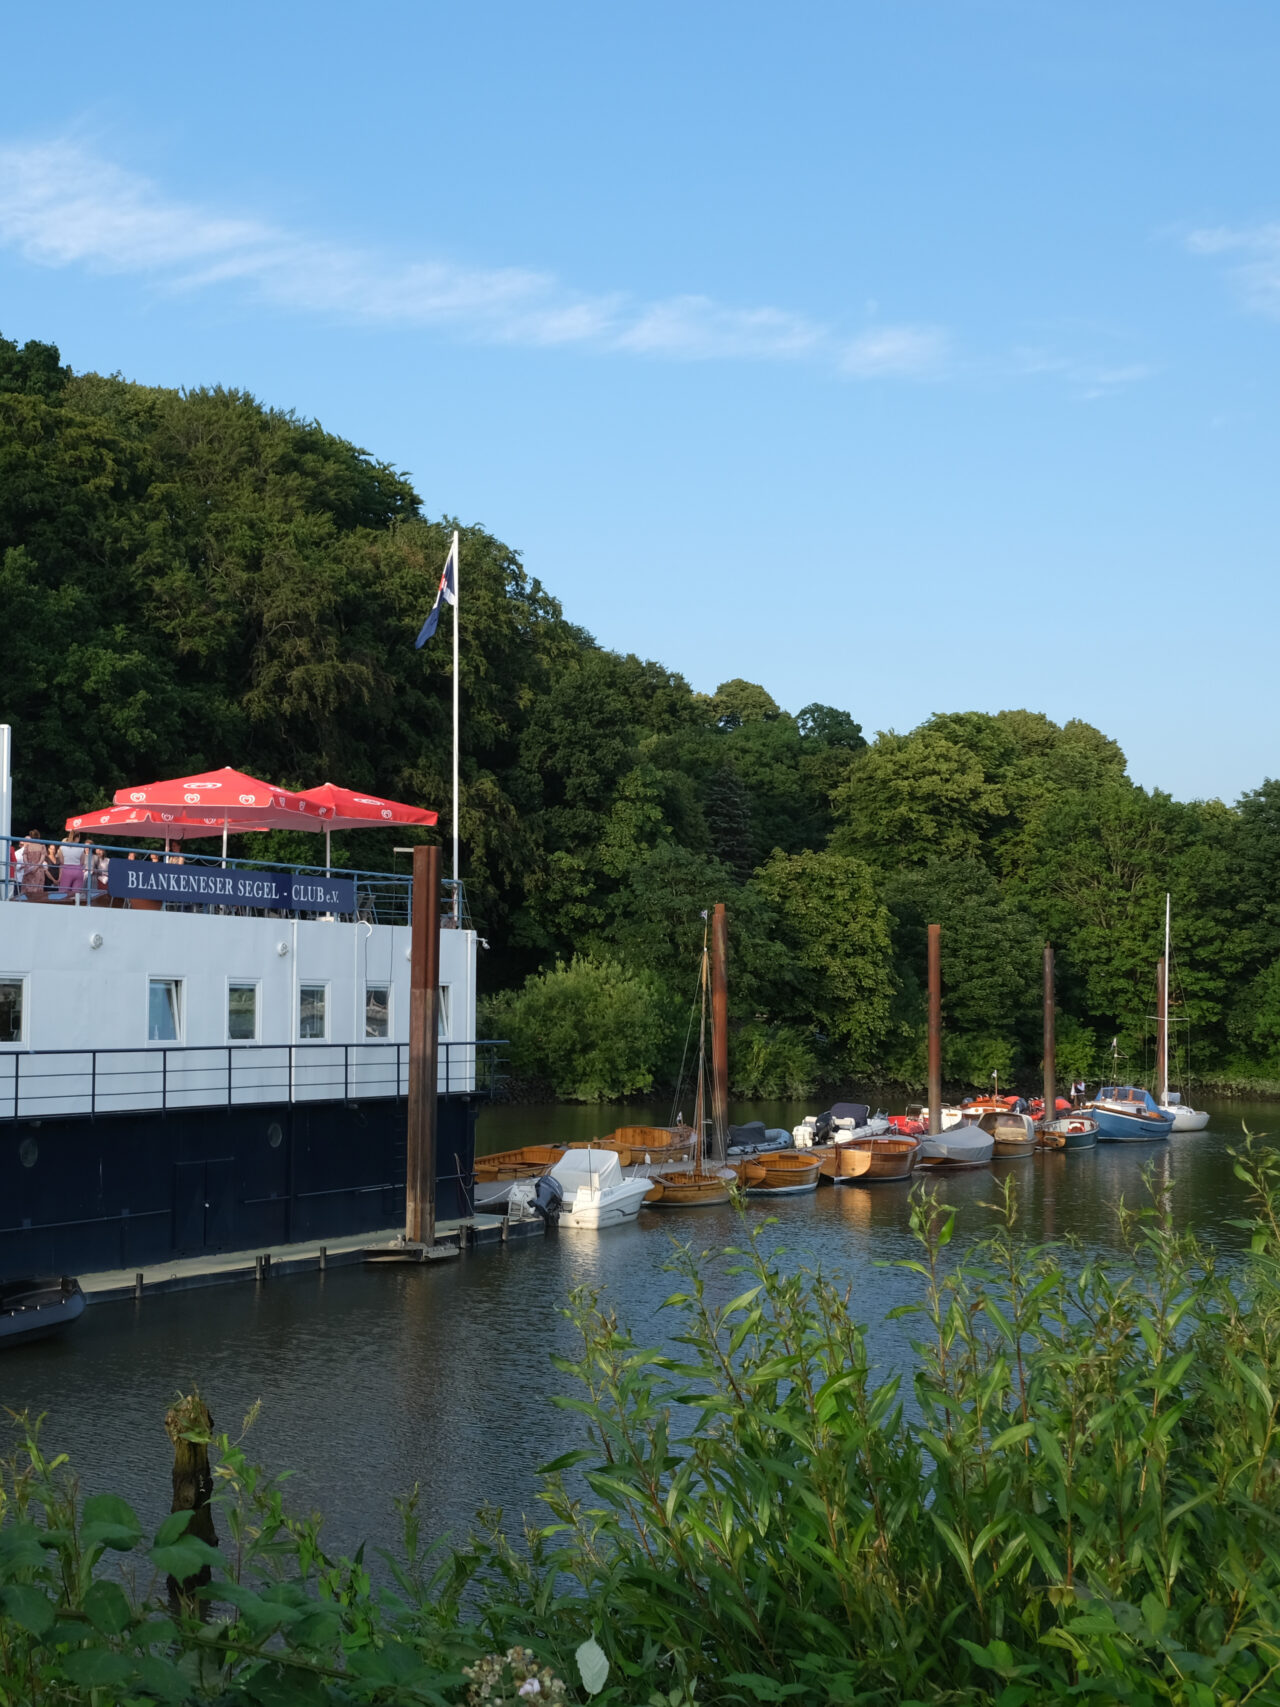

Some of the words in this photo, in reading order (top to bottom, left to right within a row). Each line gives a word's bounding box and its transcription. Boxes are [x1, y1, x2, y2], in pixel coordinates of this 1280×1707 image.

[127, 870, 234, 895] BLANKENESER
[237, 879, 280, 899] SEGEL
[291, 884, 324, 902] CLUB
